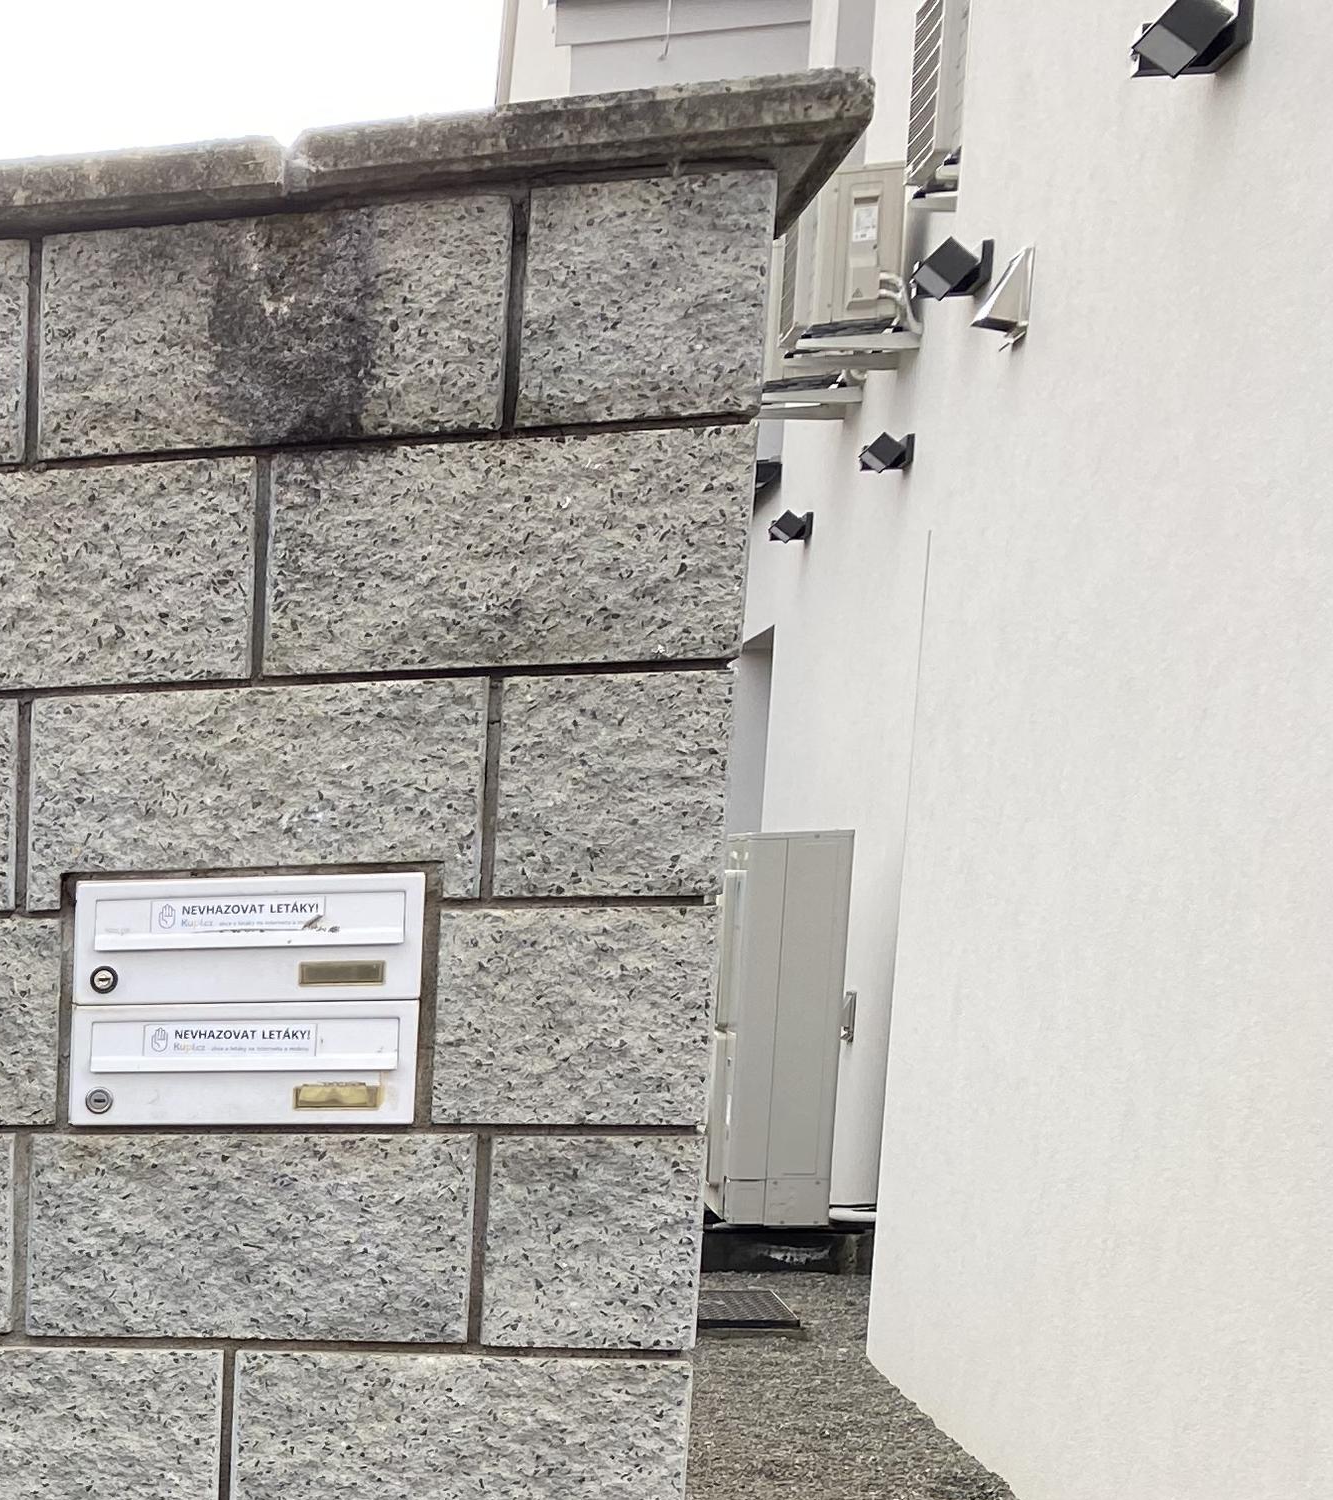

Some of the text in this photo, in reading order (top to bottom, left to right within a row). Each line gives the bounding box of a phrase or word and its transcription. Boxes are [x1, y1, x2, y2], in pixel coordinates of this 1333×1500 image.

[181, 901, 319, 915] NEVHAZOVAT LETÁKY!
[174, 1027, 311, 1040] NEVHAZOVAT LETÁKY!
